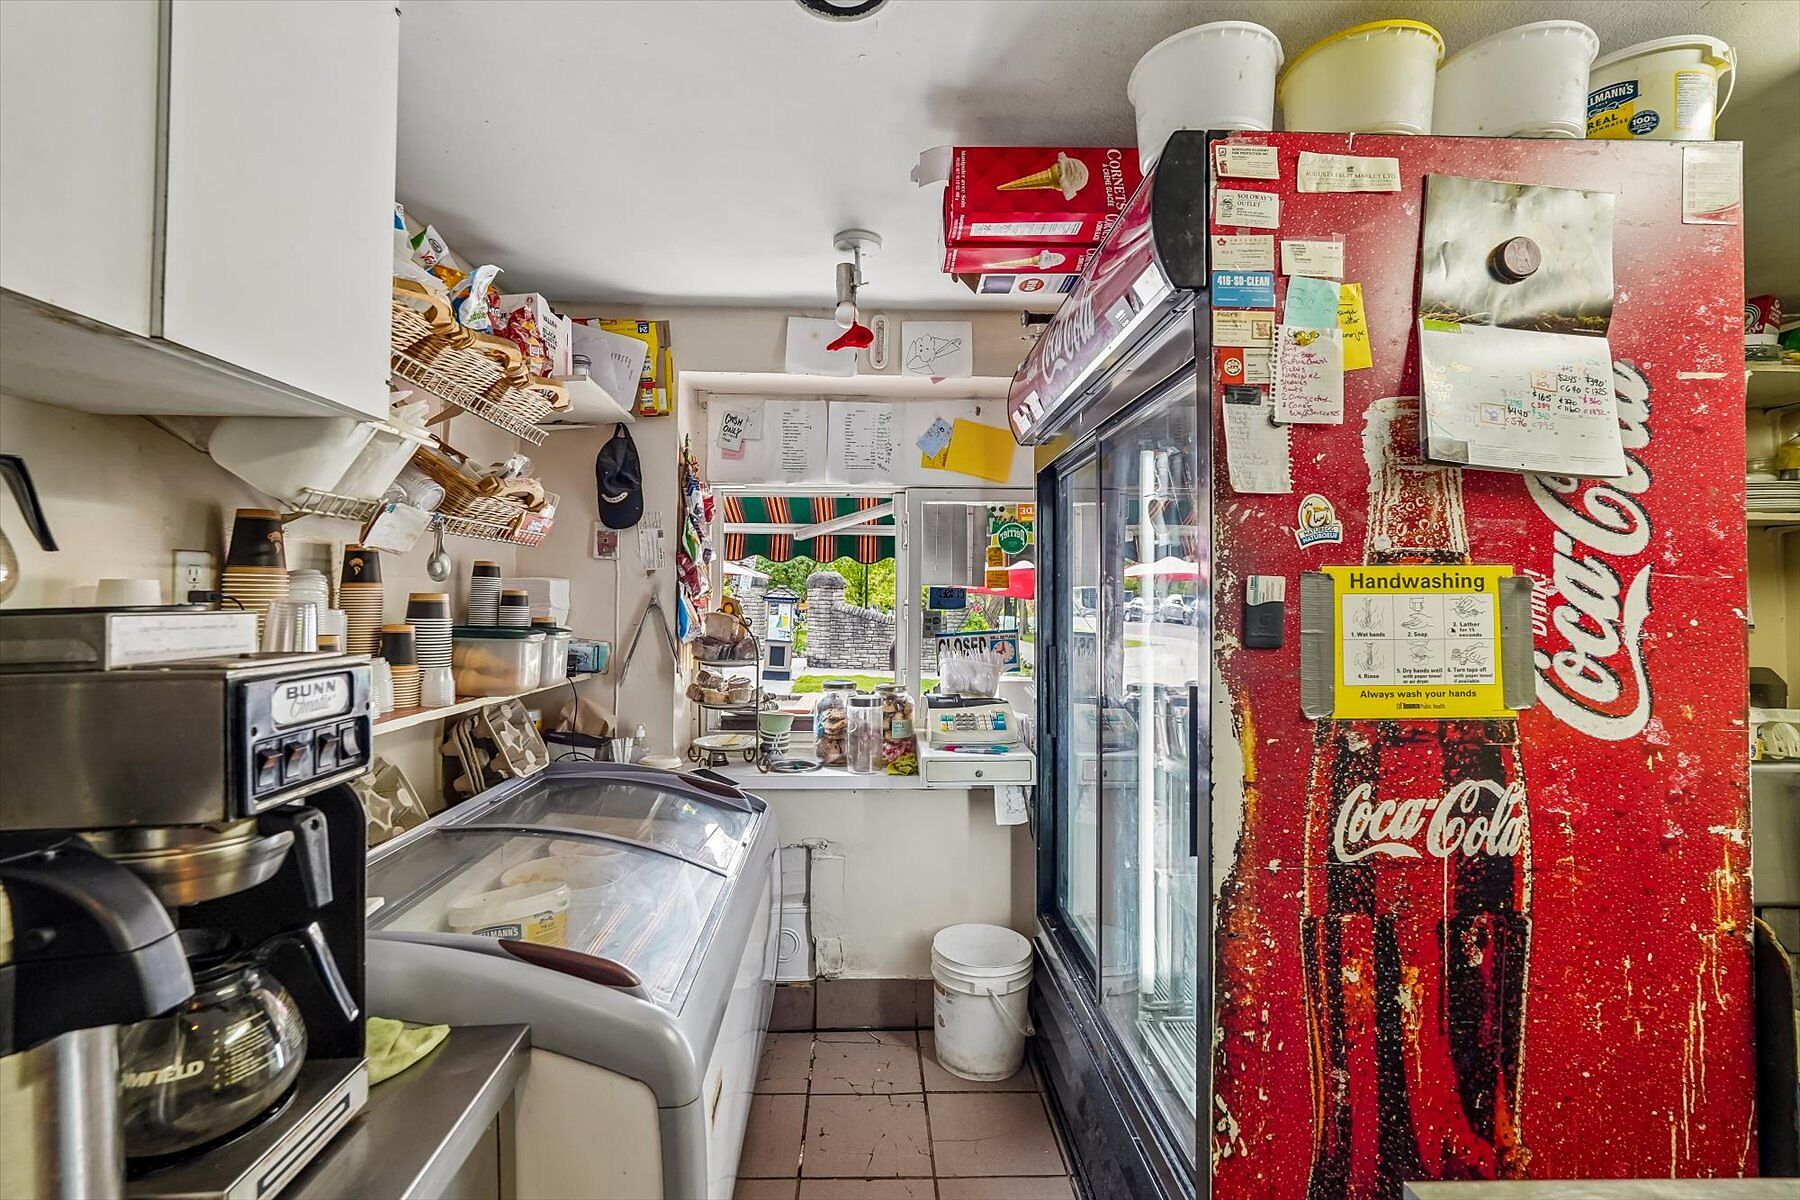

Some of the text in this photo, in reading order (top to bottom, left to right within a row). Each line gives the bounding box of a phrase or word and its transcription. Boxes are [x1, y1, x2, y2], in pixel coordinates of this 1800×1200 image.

[1590, 84, 1634, 106] LMANN'S
[1587, 118, 1629, 137] YONNAISE
[1588, 114, 1618, 130] REAL
[1350, 572, 1485, 592] Handwashing
[287, 680, 336, 699] BUNN
[1360, 689, 1476, 699] Always wash your hands
[1333, 779, 1525, 862] Coca-Cola
